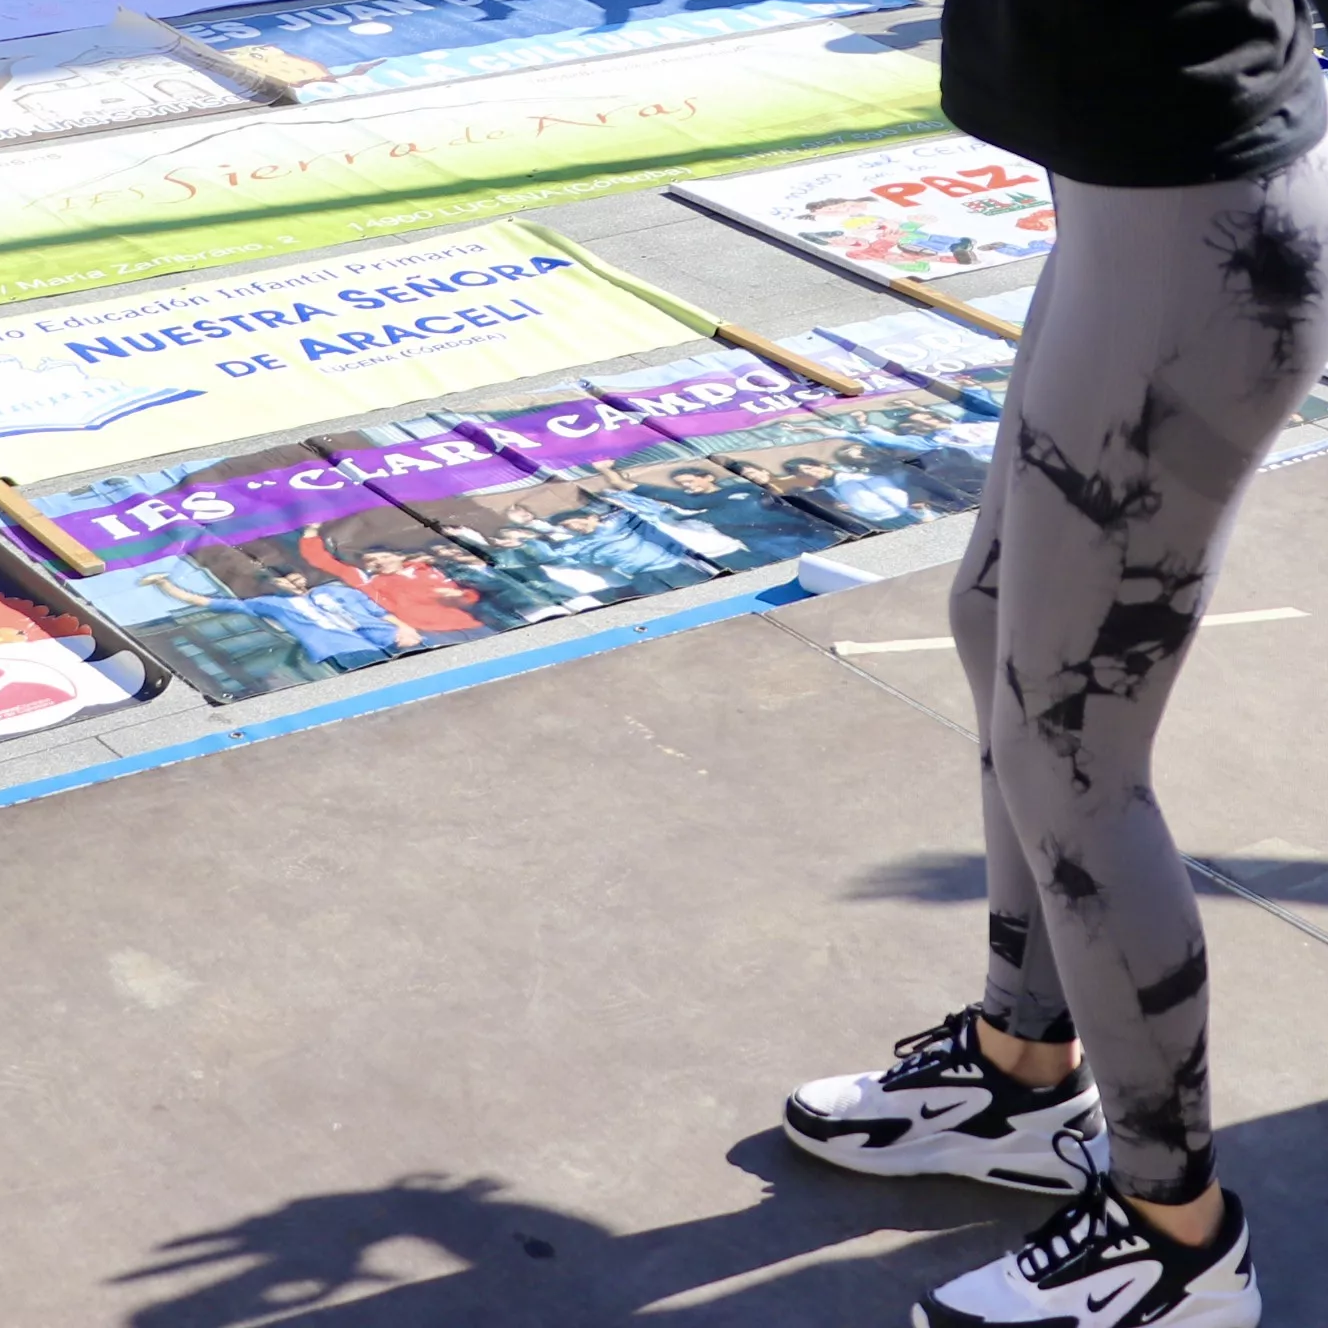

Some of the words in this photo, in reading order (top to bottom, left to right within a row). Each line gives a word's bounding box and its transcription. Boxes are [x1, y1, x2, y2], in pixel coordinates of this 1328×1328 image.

[186, 20, 262, 45] ES
[467, 23, 679, 72] CULTURA
[690, 15, 729, 35] Y
[34, 109, 109, 134] una
[153, 136, 436, 205] Sierra
[448, 125, 514, 147] de
[526, 93, 701, 136] Aras
[277, 234, 302, 247] 2
[439, 187, 562, 218] LUCENA
[869, 163, 1040, 209] PAZ
[35, 295, 211, 334] Educación
[215, 268, 342, 303] Infantil
[351, 241, 490, 278] Primaria
[65, 300, 335, 364] NUESTRA
[337, 254, 577, 311] SEÑORA
[215, 352, 289, 379] DE
[297, 298, 545, 362] ARACELI
[91, 489, 236, 542] IES
[547, 327, 970, 440] CAMPOMOR
